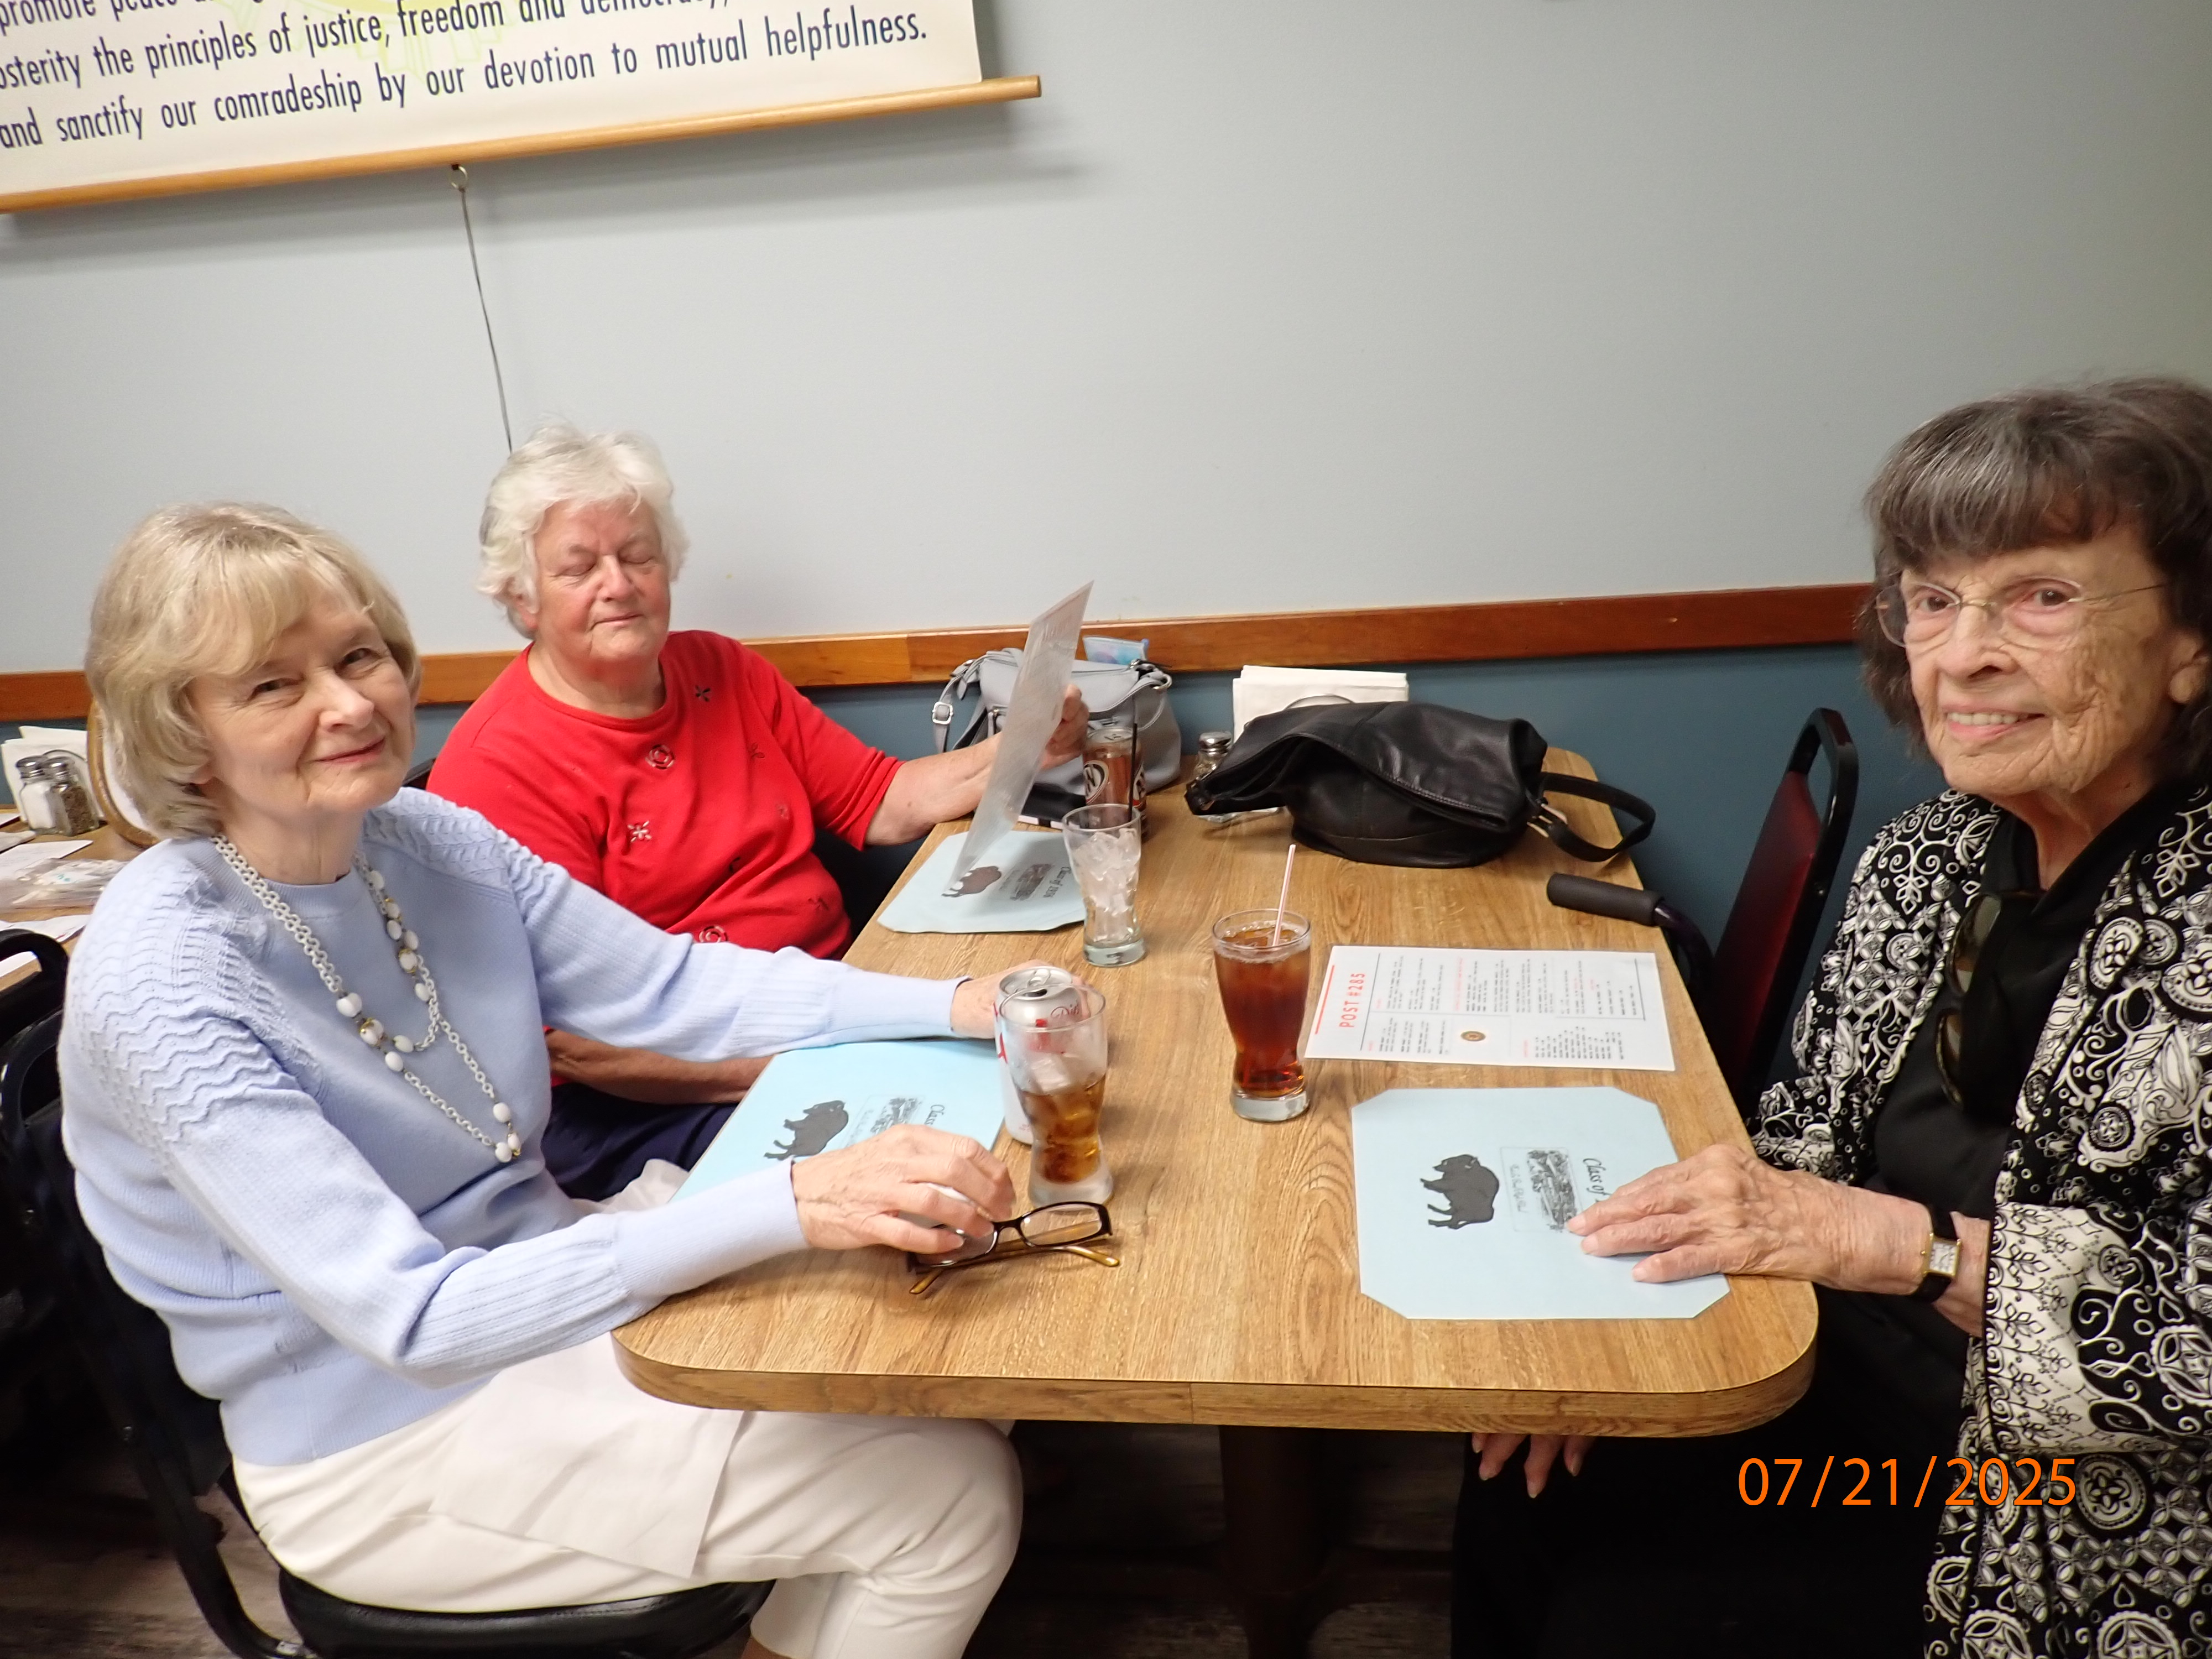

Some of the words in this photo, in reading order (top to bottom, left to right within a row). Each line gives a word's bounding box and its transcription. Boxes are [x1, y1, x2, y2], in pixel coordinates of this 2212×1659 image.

[93, 36, 133, 76] the
[145, 21, 257, 79] principles
[269, 12, 291, 54] of
[304, 9, 389, 58] justice,
[397, 0, 504, 36] freedom
[0, 107, 43, 148] and
[56, 95, 142, 142] sanctify
[161, 101, 196, 128] our
[215, 69, 362, 122] comradeship
[375, 62, 409, 108] by
[426, 68, 464, 96] our
[485, 46, 594, 89] devotion
[612, 43, 637, 74] to
[656, 19, 747, 69] mutual
[765, 5, 926, 61] helpfulness.
[1347, 973, 1365, 996] #285
[1339, 1000, 1359, 1027] POST
[1583, 1158, 1606, 1183] Class
[1586, 1185, 1612, 1196] of
